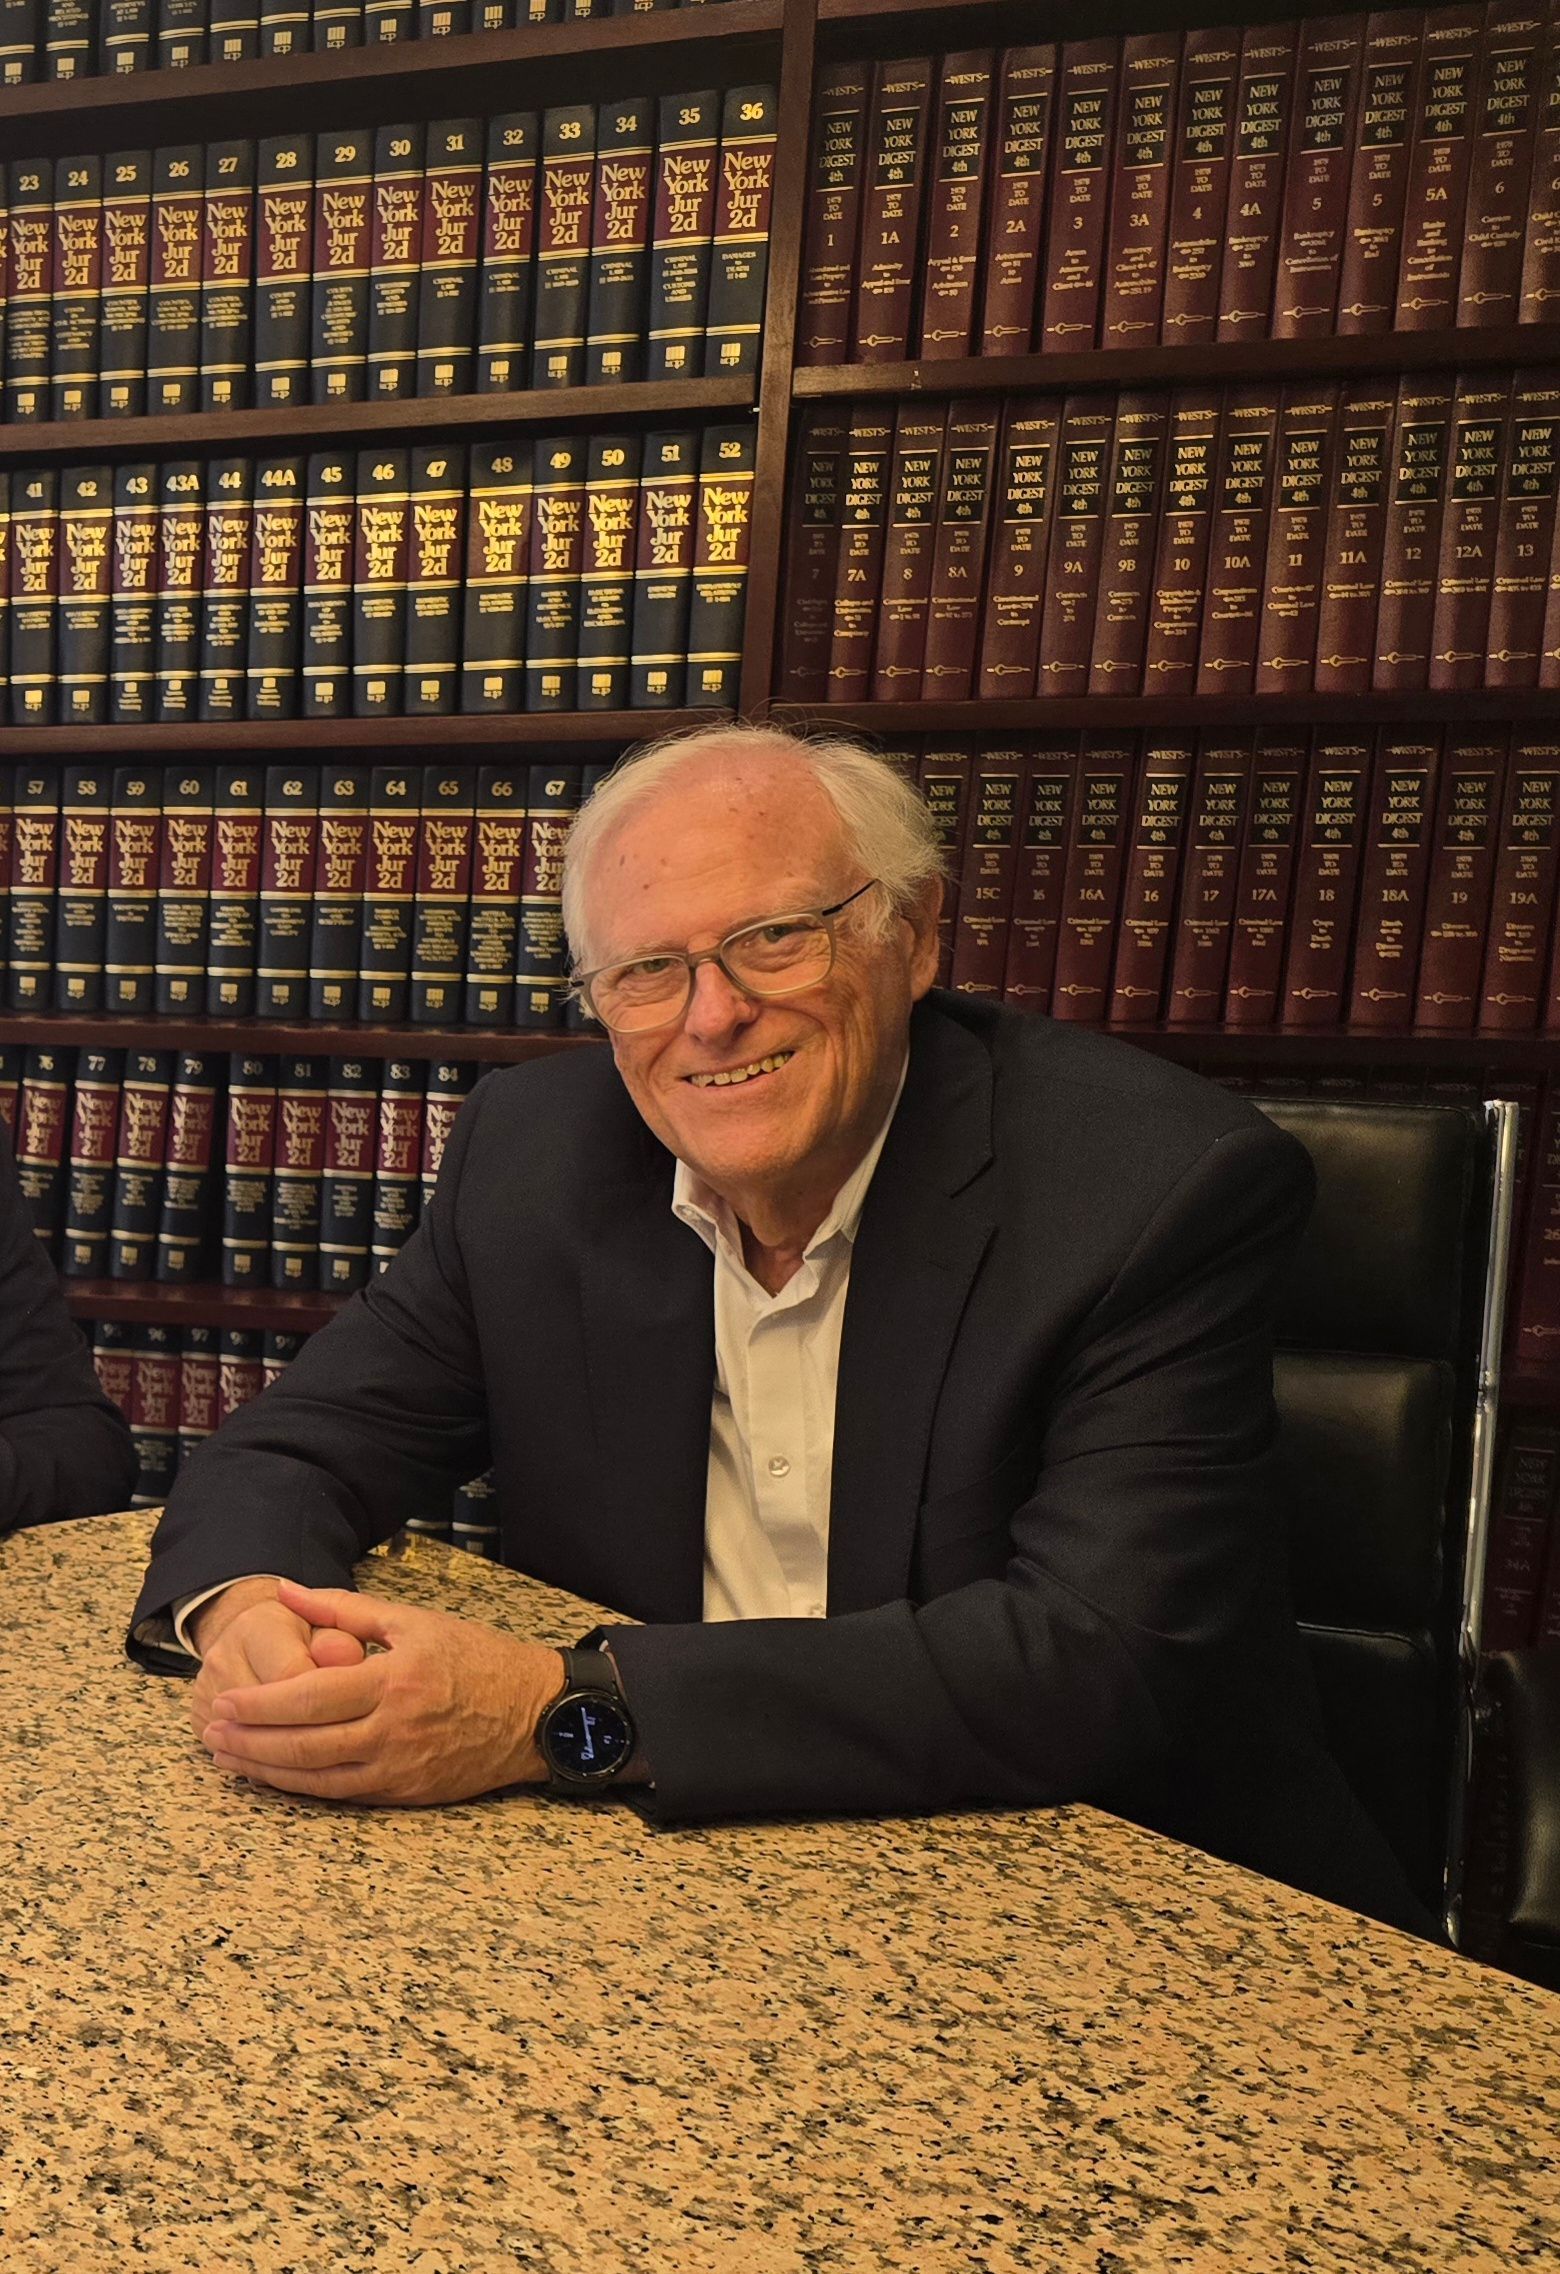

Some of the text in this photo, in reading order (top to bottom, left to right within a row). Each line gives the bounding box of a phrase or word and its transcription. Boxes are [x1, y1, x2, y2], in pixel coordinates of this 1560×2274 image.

[1434, 66, 1464, 81] NEW
[1431, 84, 1464, 99] YORK
[679, 108, 701, 125] 35
[740, 102, 763, 120] 36
[951, 109, 978, 123] NEW
[1425, 101, 1467, 117] DIGEST
[559, 122, 581, 139] 33
[615, 116, 638, 133] 34
[1434, 119, 1452, 132] 4th
[503, 129, 524, 146] 32
[948, 126, 978, 141] YORK
[389, 140, 411, 156] 30
[446, 134, 465, 151] 31
[943, 142, 980, 158] DIGEST
[276, 152, 297, 169] 28
[334, 146, 356, 162] 29
[724, 152, 772, 170] New
[115, 166, 136, 182] 25
[168, 161, 189, 178] 26
[218, 158, 238, 174] 27
[951, 159, 968, 173] 4th
[19, 175, 39, 191] 23
[68, 171, 89, 186] 24
[545, 170, 590, 188] New
[724, 171, 769, 189] York
[1425, 186, 1447, 201] 5A
[1495, 181, 1505, 194] 6
[545, 188, 589, 206] York
[727, 191, 762, 209] Jur
[1312, 197, 1322, 210] 5
[1372, 193, 1382, 207] 5
[264, 199, 306, 216] New
[882, 210, 903, 218] DATE
[946, 202, 967, 211] DATE
[1192, 207, 1202, 219] 4
[1240, 202, 1261, 216] 4A
[105, 212, 146, 228] New
[264, 216, 306, 234] York
[549, 208, 582, 226] Jur
[729, 209, 757, 229] 2d
[1073, 217, 1083, 230] 3
[1129, 214, 1150, 227] 3A
[950, 225, 958, 238] 2
[1006, 219, 1026, 234] 2A
[105, 230, 145, 246] York
[552, 226, 578, 244] 2d
[827, 234, 834, 247] 1
[881, 231, 900, 245] 1A
[269, 235, 300, 253] Jur
[109, 247, 140, 264] Jur
[272, 253, 297, 270] 2d
[112, 264, 135, 281] 2d
[601, 449, 625, 466] 50
[661, 445, 680, 462] 51
[719, 442, 741, 459] 52
[491, 457, 513, 473] 48
[550, 452, 571, 468] 49
[1016, 455, 1042, 468] NEW
[321, 467, 342, 483] 45
[372, 464, 394, 480] 46
[426, 461, 447, 477] 47
[126, 478, 148, 493] 43
[166, 475, 199, 491] 43A
[218, 472, 241, 488] 44
[261, 469, 295, 486] 44A
[1013, 471, 1042, 484] YORK
[26, 483, 42, 497] 41
[77, 482, 97, 497] 42
[702, 487, 749, 506] New
[1007, 487, 1045, 500] DIGEST
[478, 501, 523, 519] New
[703, 506, 748, 524] York
[1016, 502, 1032, 515] 4th
[256, 514, 298, 531] New
[479, 519, 522, 536] York
[67, 523, 106, 539] New
[706, 526, 741, 544] Jur
[255, 531, 296, 548] York
[483, 537, 515, 554] Jur
[68, 542, 105, 557] York
[259, 548, 290, 566] Jur
[708, 542, 736, 561] 2d
[1339, 551, 1368, 564] 11A
[1405, 548, 1421, 560] 12
[1455, 545, 1482, 558] 12A
[1517, 544, 1534, 557] 13
[71, 558, 100, 575] Jur
[485, 554, 512, 572] 2d
[1064, 561, 1083, 574] 9A
[1118, 559, 1136, 572] 9B
[1174, 558, 1191, 571] 10
[1224, 556, 1251, 569] 10A
[1288, 554, 1302, 567] 11
[262, 565, 286, 582] 2d
[847, 569, 866, 582] 7A
[903, 568, 912, 580] 8
[948, 566, 968, 578] 8A
[1014, 564, 1024, 577] 9
[72, 574, 97, 591] 2d
[28, 780, 44, 794] 57
[77, 780, 96, 795] 58
[127, 781, 145, 796] 59
[180, 780, 200, 795] 60
[230, 780, 248, 796] 61
[282, 780, 303, 795] 62
[334, 780, 354, 796] 63
[386, 780, 407, 796] 64
[438, 780, 459, 796] 65
[491, 782, 512, 796] 66
[545, 780, 566, 796] 67
[1324, 781, 1353, 792] NEW
[1321, 797, 1352, 809] YORK
[16, 819, 54, 836] New
[1315, 814, 1357, 825] DIGEST
[272, 821, 311, 838] New
[478, 822, 522, 840] New
[1325, 828, 1341, 839] 4th
[16, 836, 52, 851] York
[272, 838, 310, 854] York
[479, 840, 520, 856] York
[20, 851, 47, 868] Jur
[274, 854, 303, 871] Jur
[482, 856, 514, 874] Jur
[22, 866, 44, 882] 2d
[276, 870, 299, 887] 2d
[484, 874, 509, 890] 2d
[976, 888, 1000, 900] 15C
[1079, 889, 1104, 901] 16A
[1144, 890, 1159, 902] 16
[1203, 890, 1219, 901] 17
[1252, 888, 1278, 900] 17A
[1319, 889, 1335, 900] 18
[1382, 889, 1409, 901] 18A
[1451, 891, 1468, 903] 19
[1510, 892, 1537, 904] 19A
[88, 1055, 106, 1071] 77
[138, 1056, 156, 1072] 78
[184, 1059, 203, 1075] 79
[342, 1064, 362, 1078] 82
[390, 1064, 410, 1079] 83
[438, 1067, 458, 1081] 84
[331, 1101, 370, 1117] New
[332, 1117, 369, 1136] York
[335, 1135, 363, 1150] Jur
[337, 1149, 359, 1167] 2d
